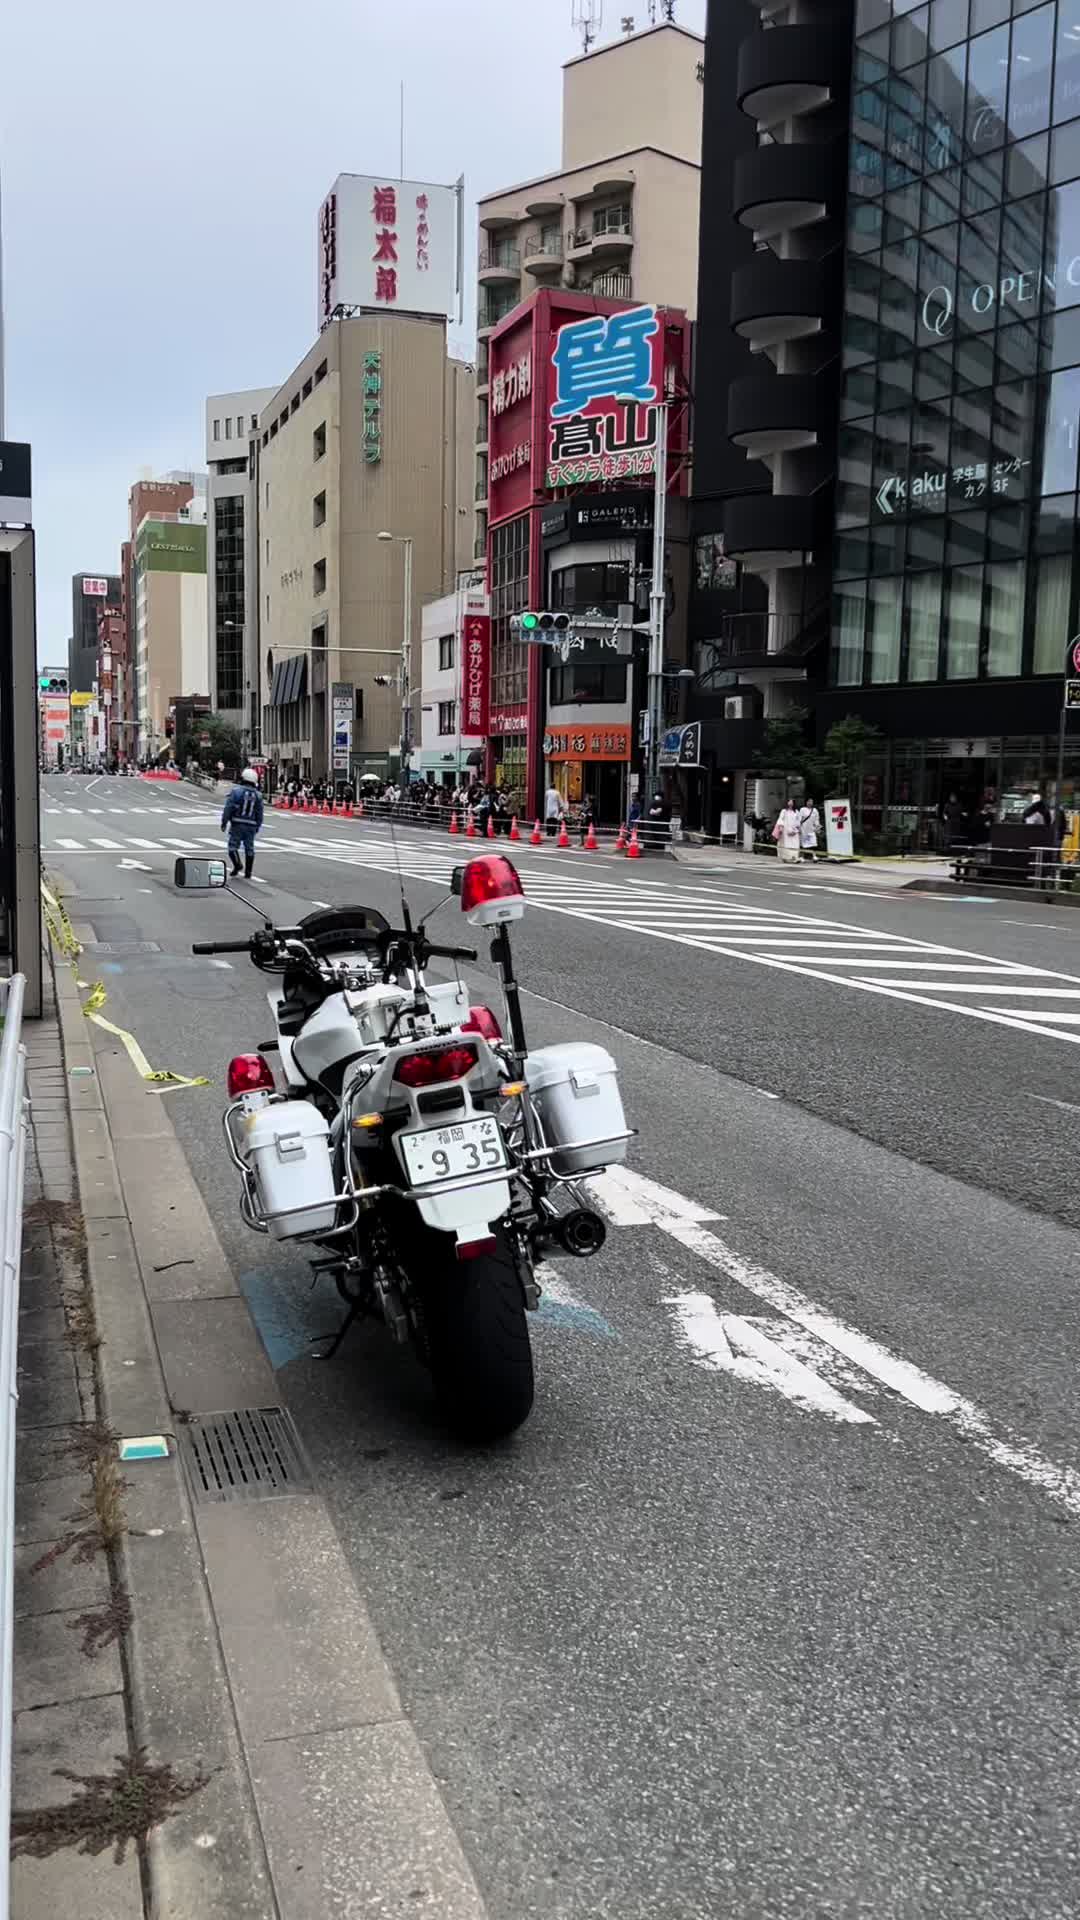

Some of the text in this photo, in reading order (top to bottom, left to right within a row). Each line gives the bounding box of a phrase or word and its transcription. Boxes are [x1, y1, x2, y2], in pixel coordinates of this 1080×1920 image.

[370, 185, 398, 304] 福太郎
[972, 264, 1056, 313] OPEN
[550, 304, 660, 417] 質
[361, 351, 381, 464] 天神テルラ
[964, 477, 1009, 498] カク 3F
[994, 456, 1031, 474] センター
[468, 639, 483, 725] あかひげ薬局
[438, 1127, 465, 1144] 福岡
